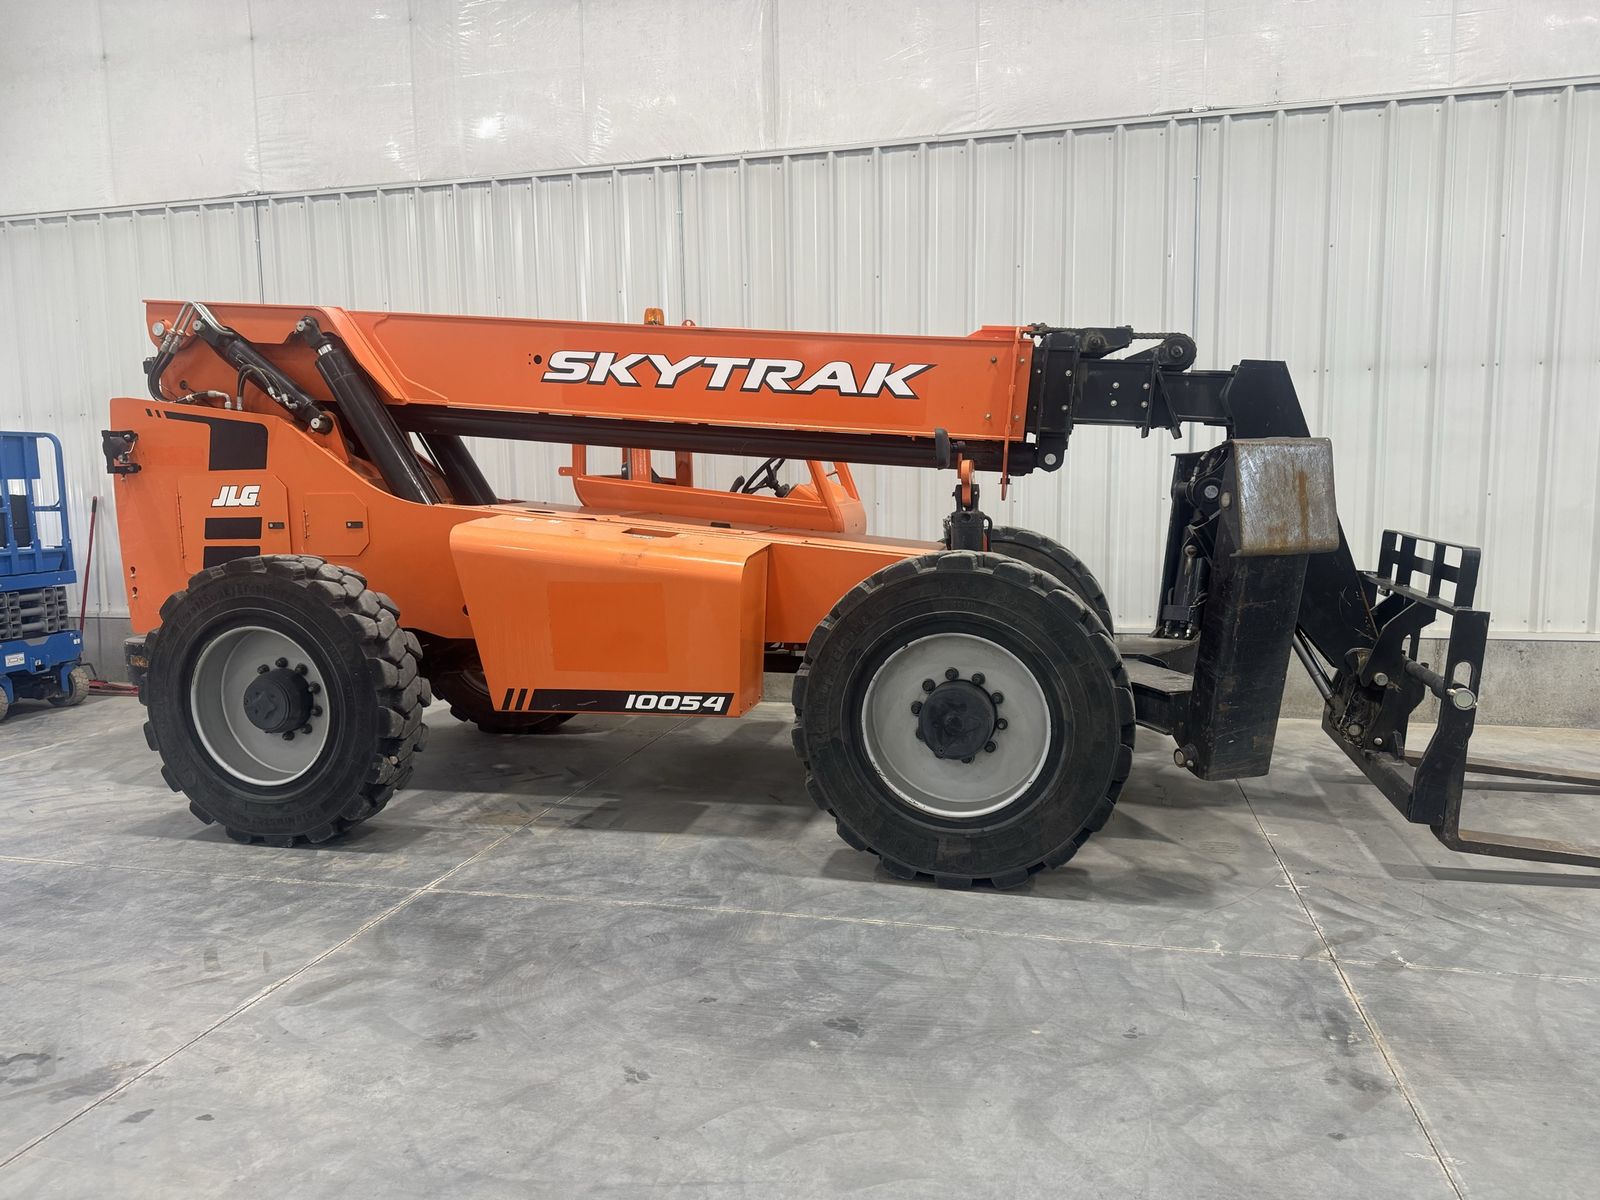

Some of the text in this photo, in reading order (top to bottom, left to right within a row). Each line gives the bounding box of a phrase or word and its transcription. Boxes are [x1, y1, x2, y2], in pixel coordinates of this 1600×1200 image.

[540, 350, 938, 400] SKYTRAK
[211, 485, 260, 507] JLG
[625, 694, 726, 712] 10054
